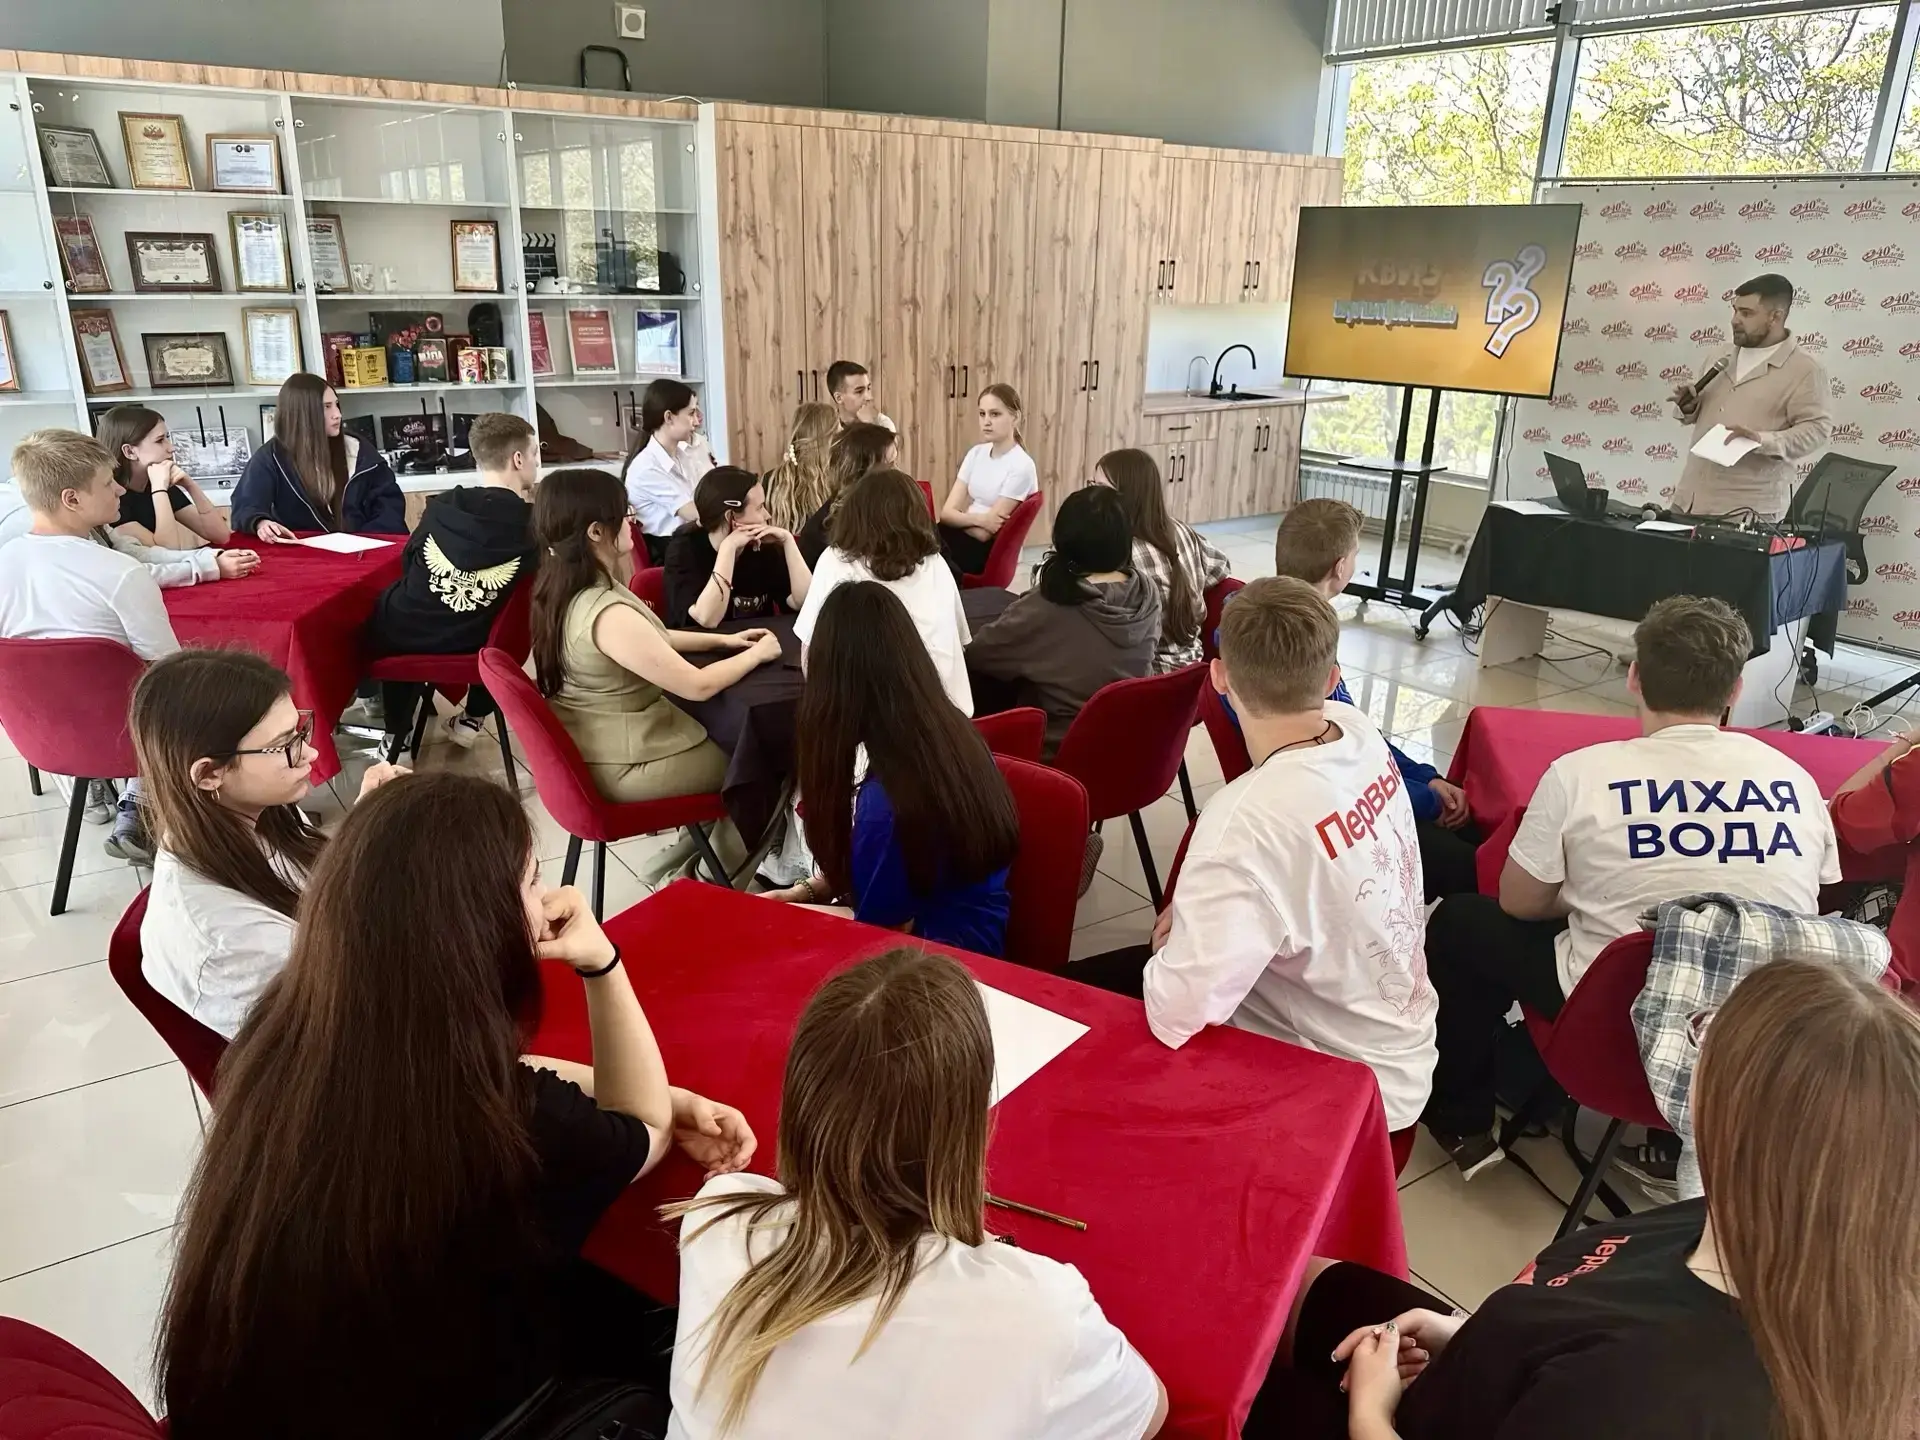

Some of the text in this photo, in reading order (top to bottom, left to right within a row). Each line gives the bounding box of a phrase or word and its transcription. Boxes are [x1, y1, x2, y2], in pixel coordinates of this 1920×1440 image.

[1608, 779, 1800, 815] ТИХАЯ
[1627, 822, 1802, 864] ВОДА
[1546, 1235, 1632, 1287] Перве
